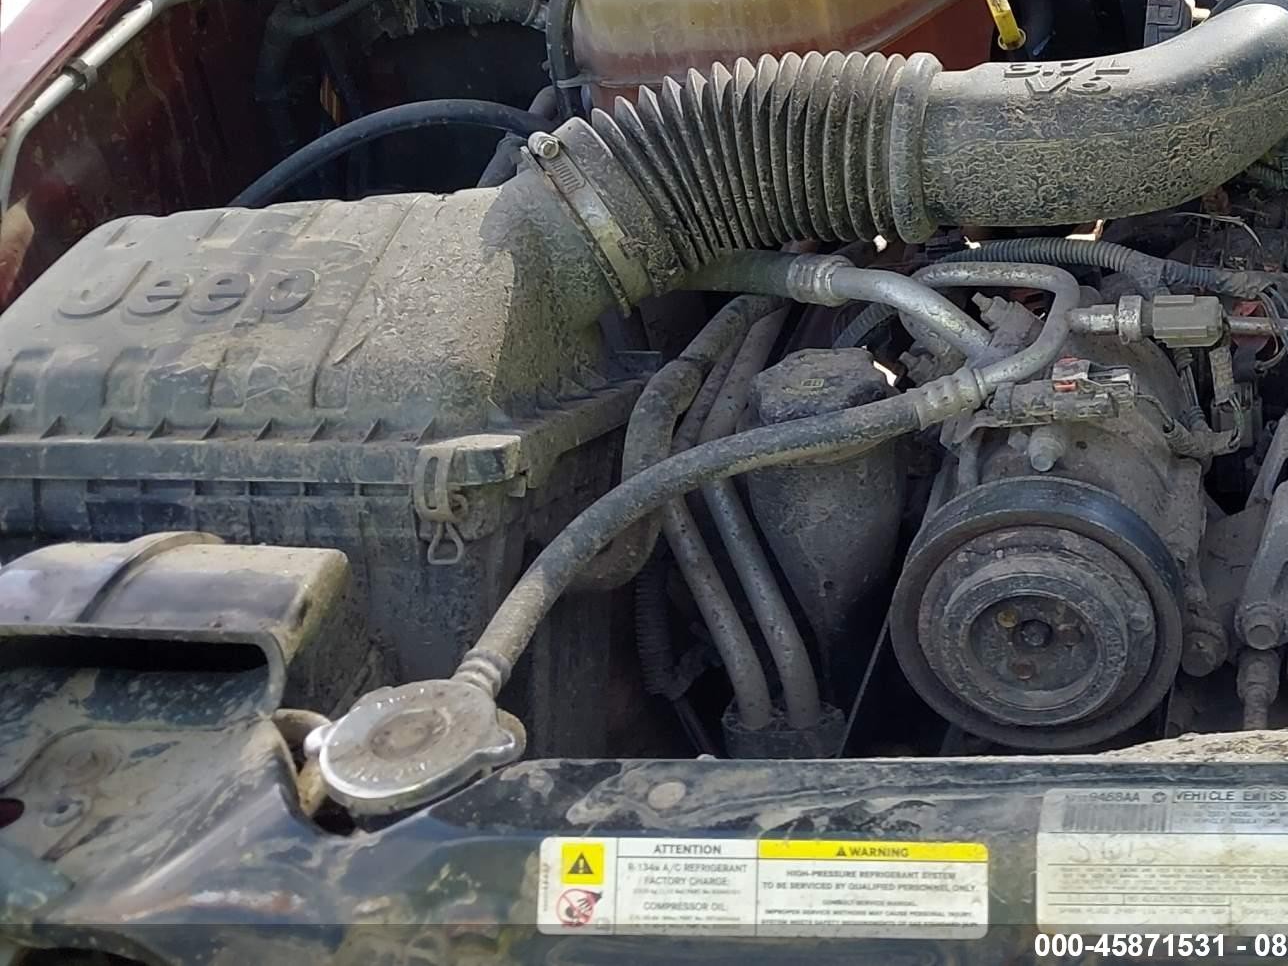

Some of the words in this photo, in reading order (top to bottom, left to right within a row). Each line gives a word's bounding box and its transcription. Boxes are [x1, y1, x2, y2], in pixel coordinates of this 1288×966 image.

[1003, 59, 1131, 78] 3.7L
[1024, 76, 1112, 95] V6
[57, 260, 320, 326] Jeep
[1174, 790, 1234, 802] VEHICLE
[653, 844, 722, 855] ATTENTION
[850, 847, 910, 858] WARNING
[663, 863, 681, 873] A/C
[684, 863, 748, 873] REFRIGERANT
[785, 869, 857, 879] HIGH-PRESSURE
[859, 870, 919, 880] REFRIGERANT
[644, 876, 687, 885] FACTORY
[763, 881, 774, 890] TO
[776, 881, 787, 890] BE
[789, 881, 833, 891] SERVICED
[834, 882, 846, 891] BY
[848, 882, 896, 892] QUALIFIED
[897, 882, 951, 893] PERSONNEL
[643, 901, 709, 911] COMPRESSOR
